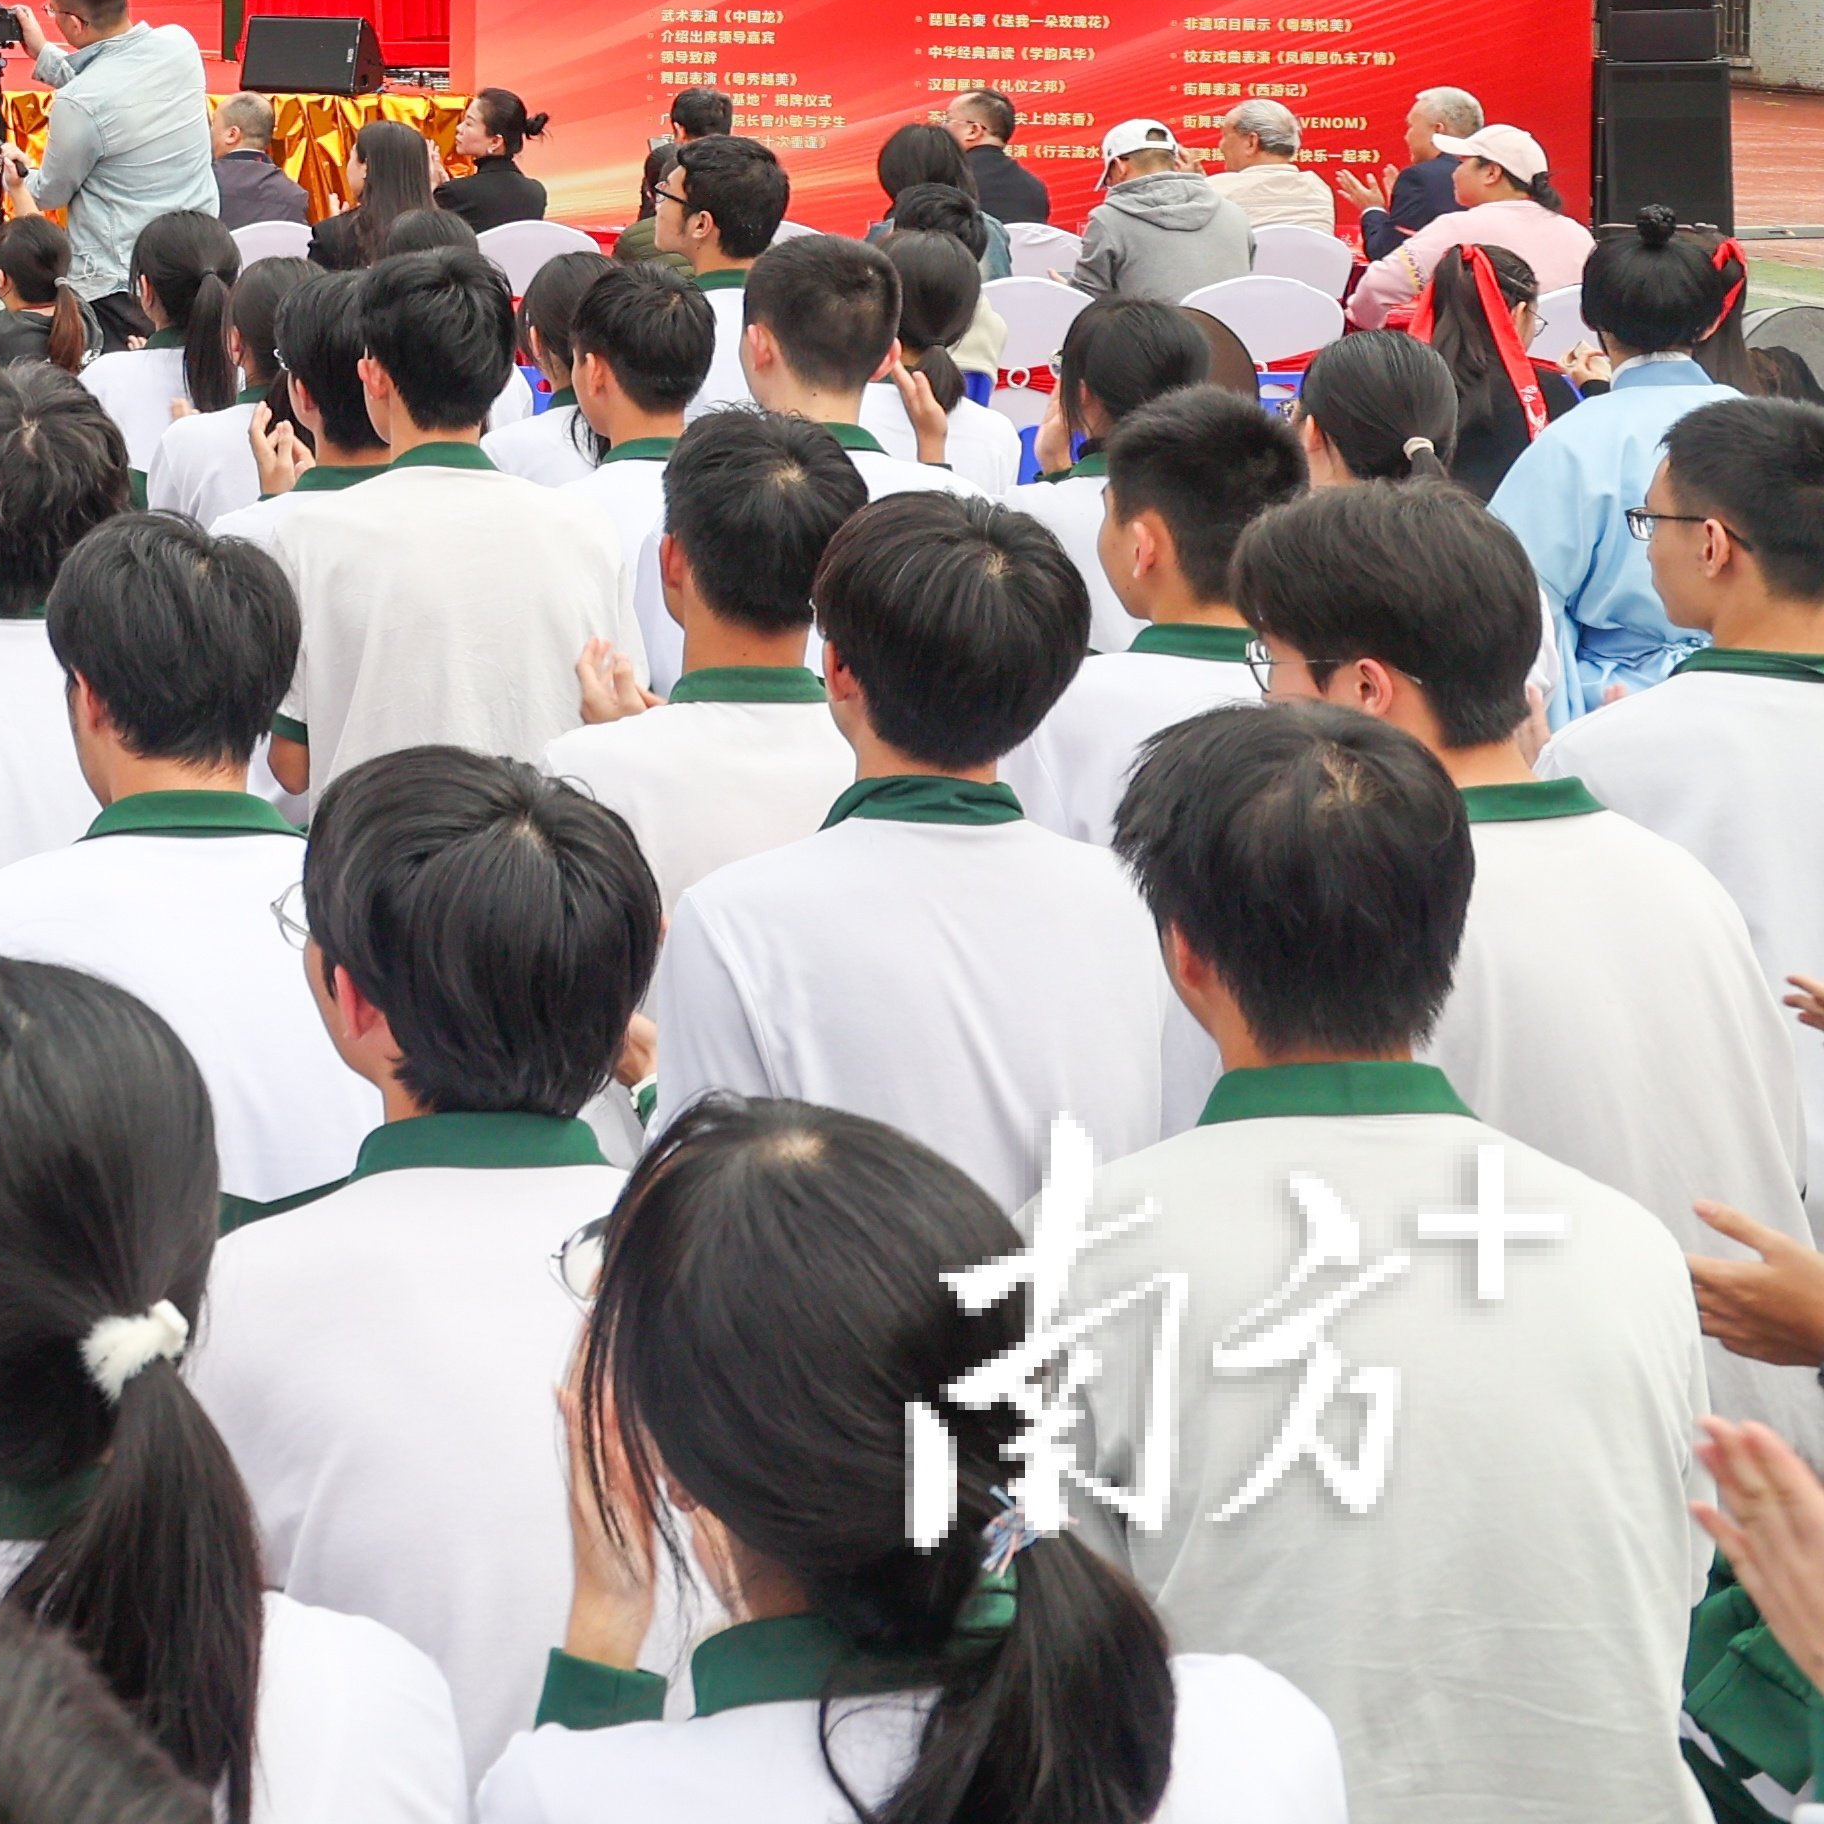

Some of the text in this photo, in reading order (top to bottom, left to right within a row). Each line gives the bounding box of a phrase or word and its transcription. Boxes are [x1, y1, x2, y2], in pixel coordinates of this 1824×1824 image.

[660, 9, 784, 24] 武术表演《中国龙》
[660, 30, 776, 45] 介绍出席领导嘉宾
[660, 50, 718, 65] 领导致辞
